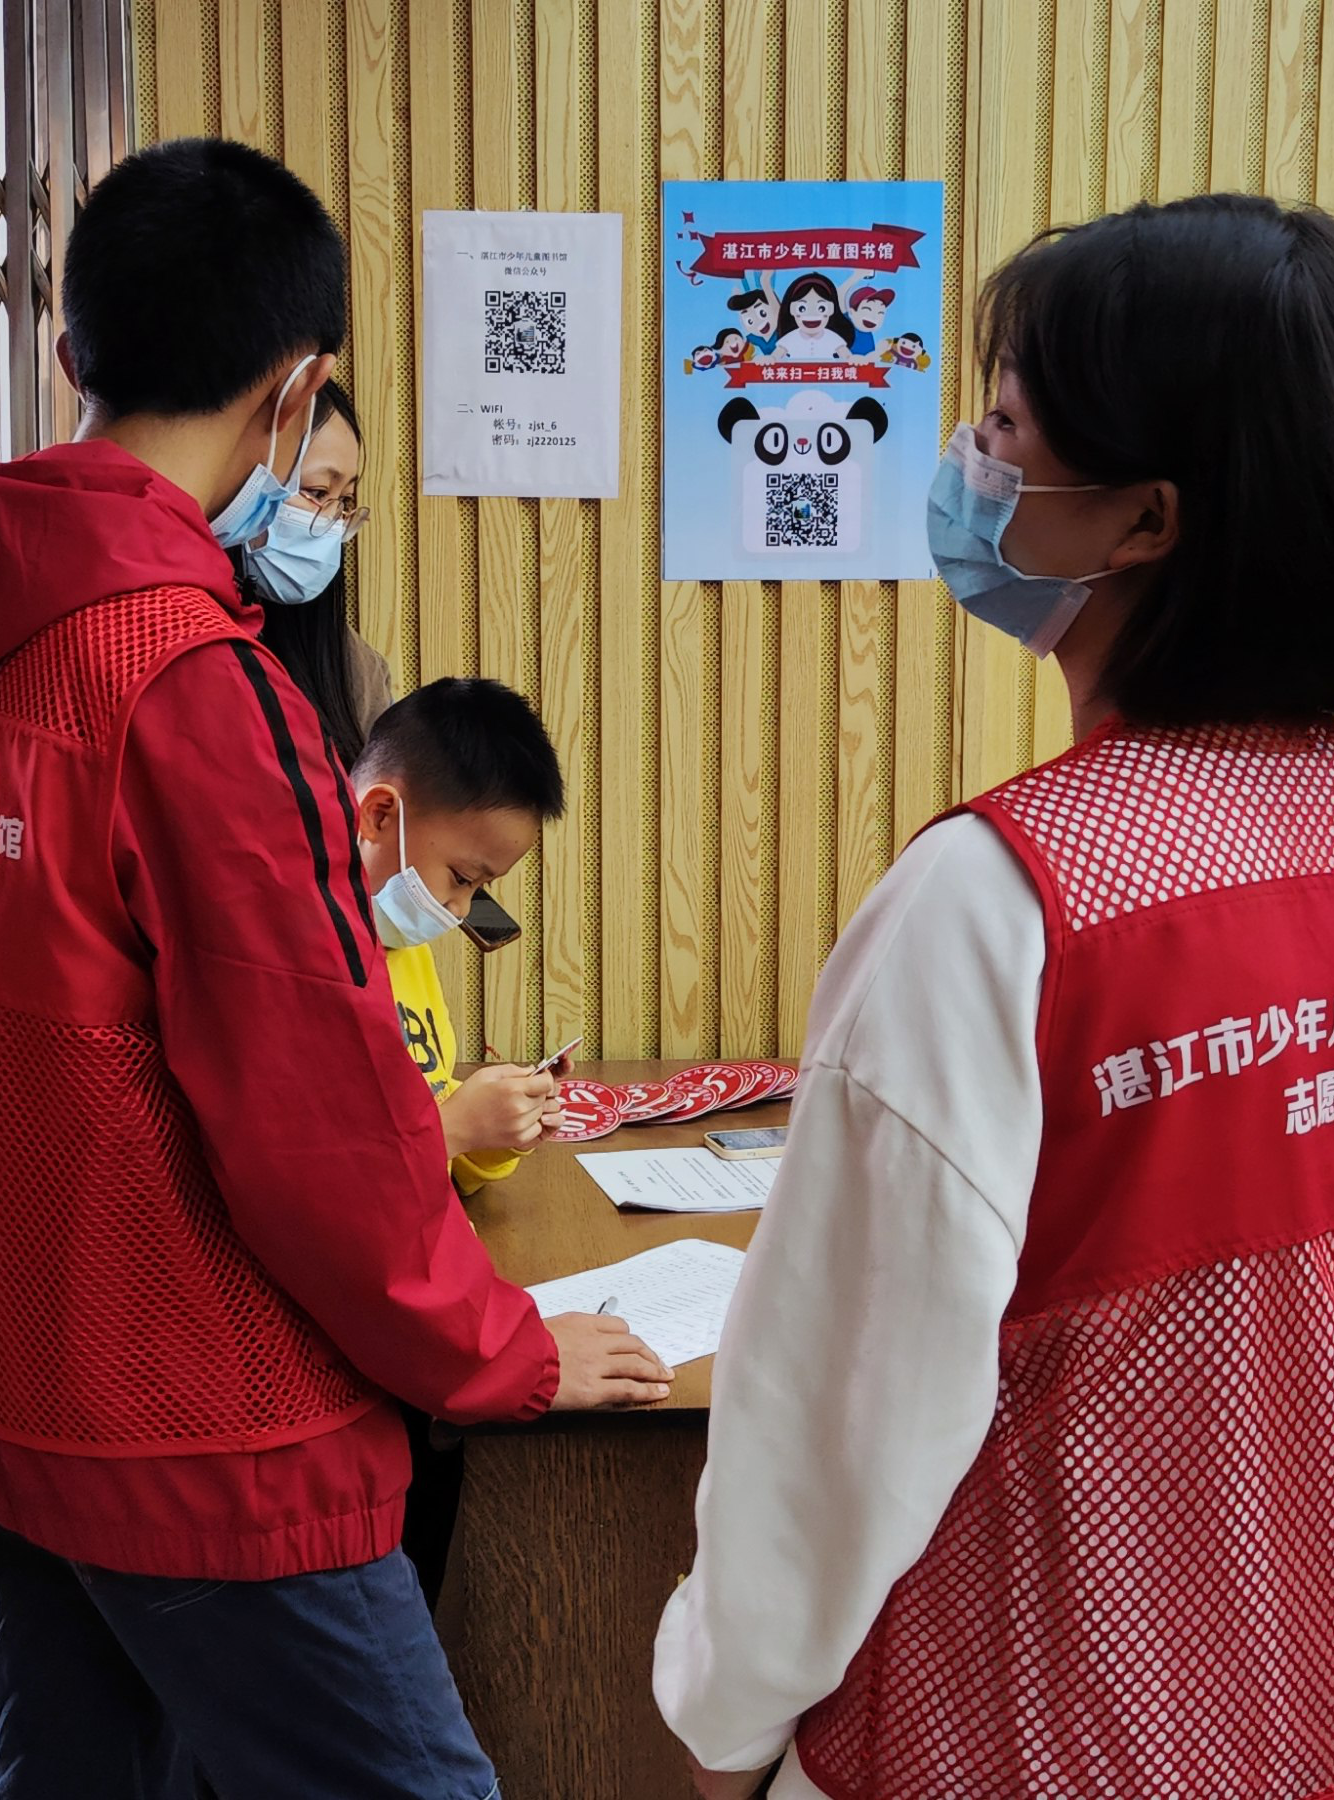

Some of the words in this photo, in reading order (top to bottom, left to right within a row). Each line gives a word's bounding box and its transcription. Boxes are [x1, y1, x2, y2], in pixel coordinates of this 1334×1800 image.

[722, 242, 895, 261] 湛江市少年儿童图书馆
[761, 366, 858, 381] 快来扫一扫我哦
